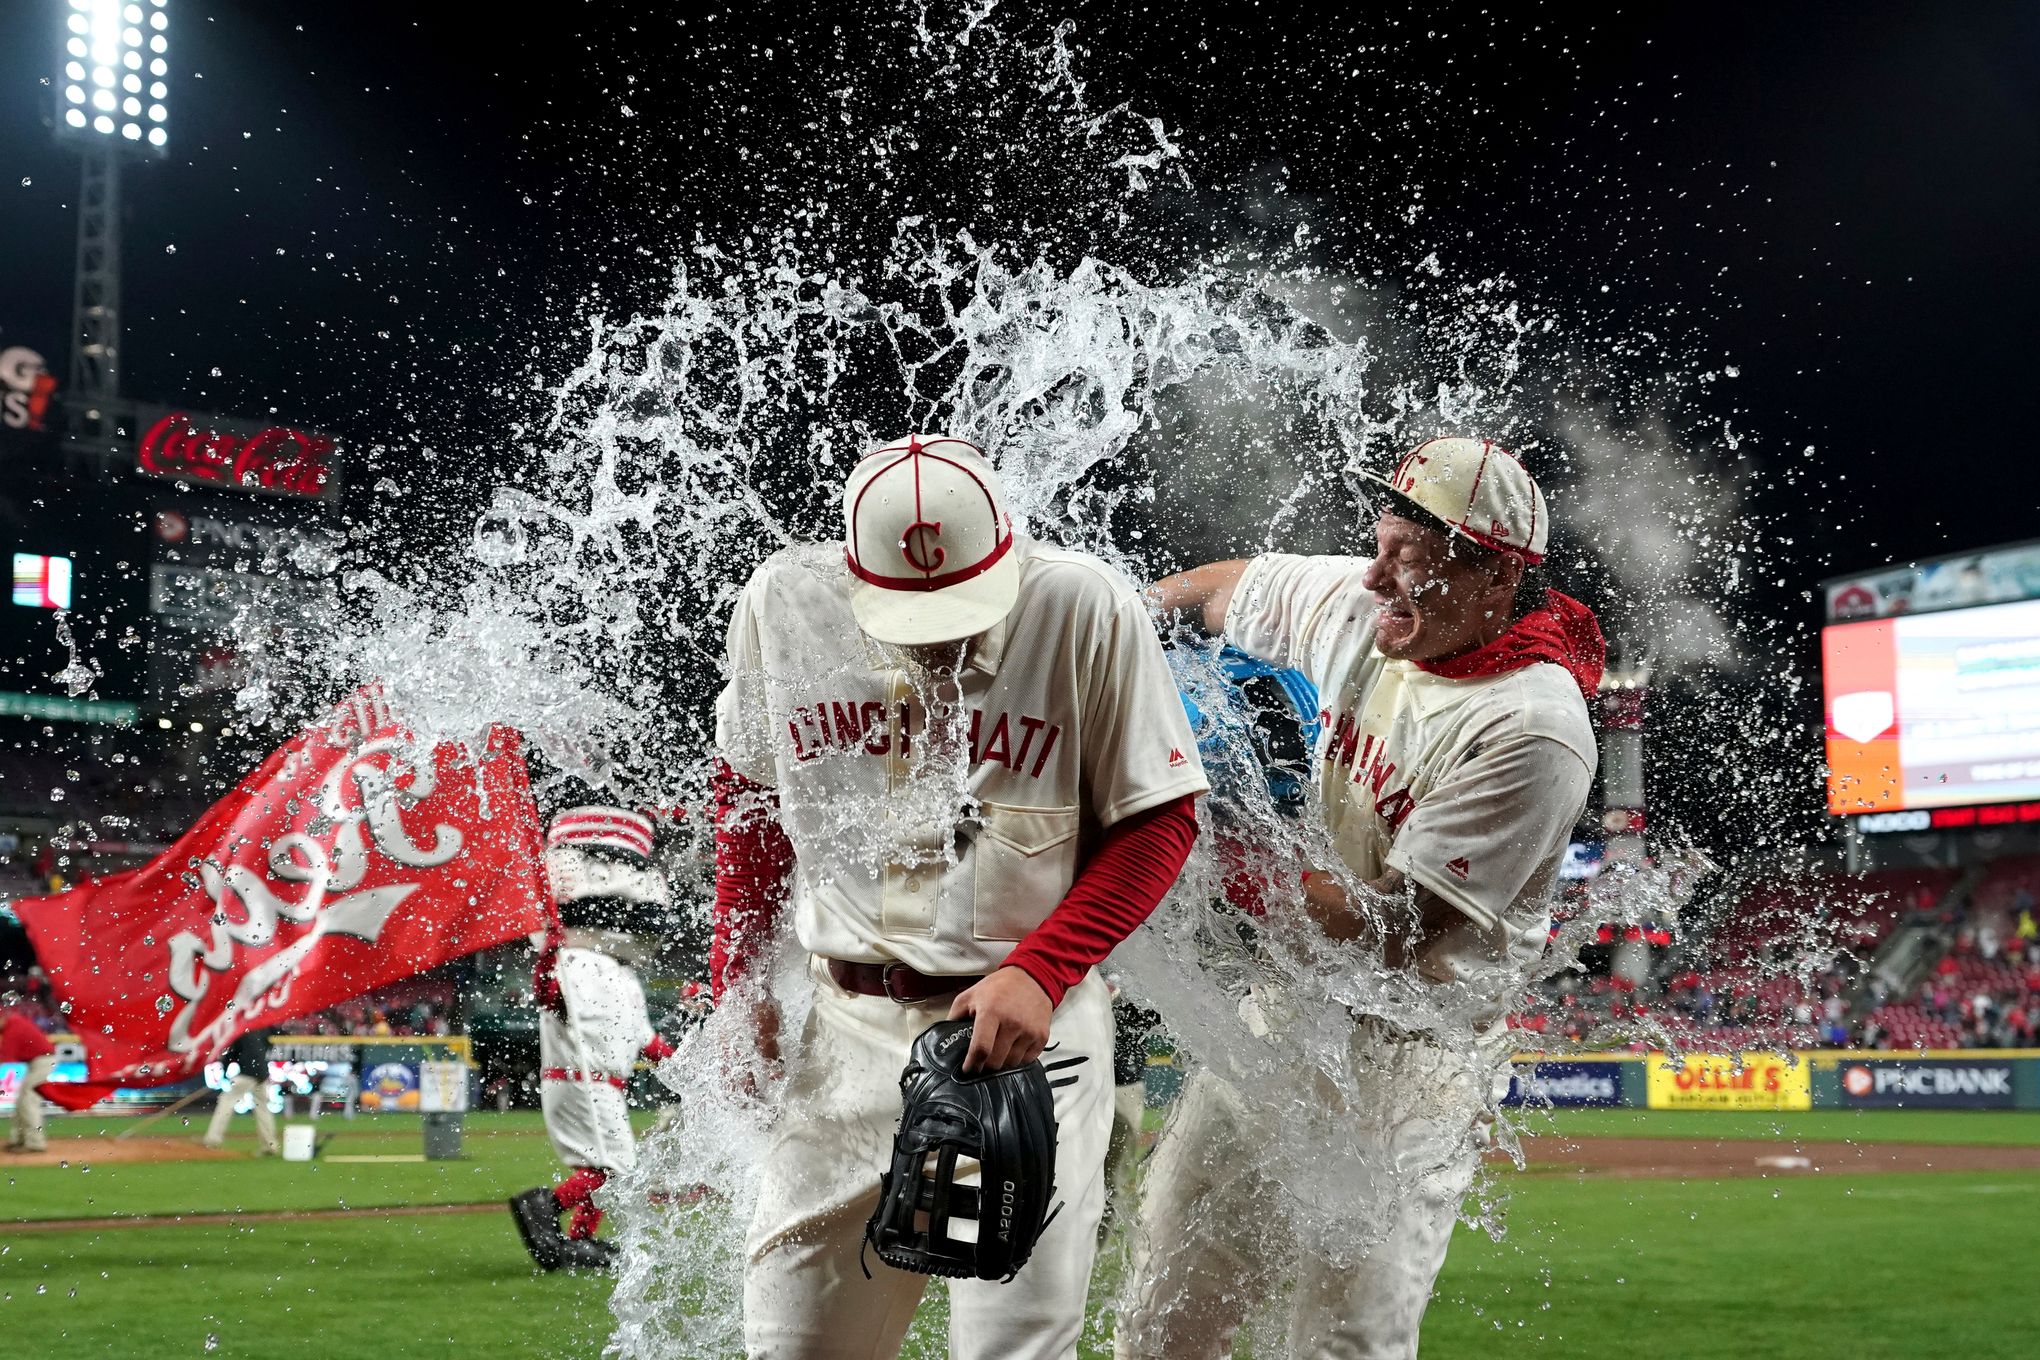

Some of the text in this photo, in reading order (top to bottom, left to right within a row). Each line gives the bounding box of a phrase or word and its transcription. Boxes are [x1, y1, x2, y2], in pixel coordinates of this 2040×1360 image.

[901, 521, 945, 573] C
[789, 701, 1060, 778] CINCIATI
[998, 1180, 1015, 1242] A2000
